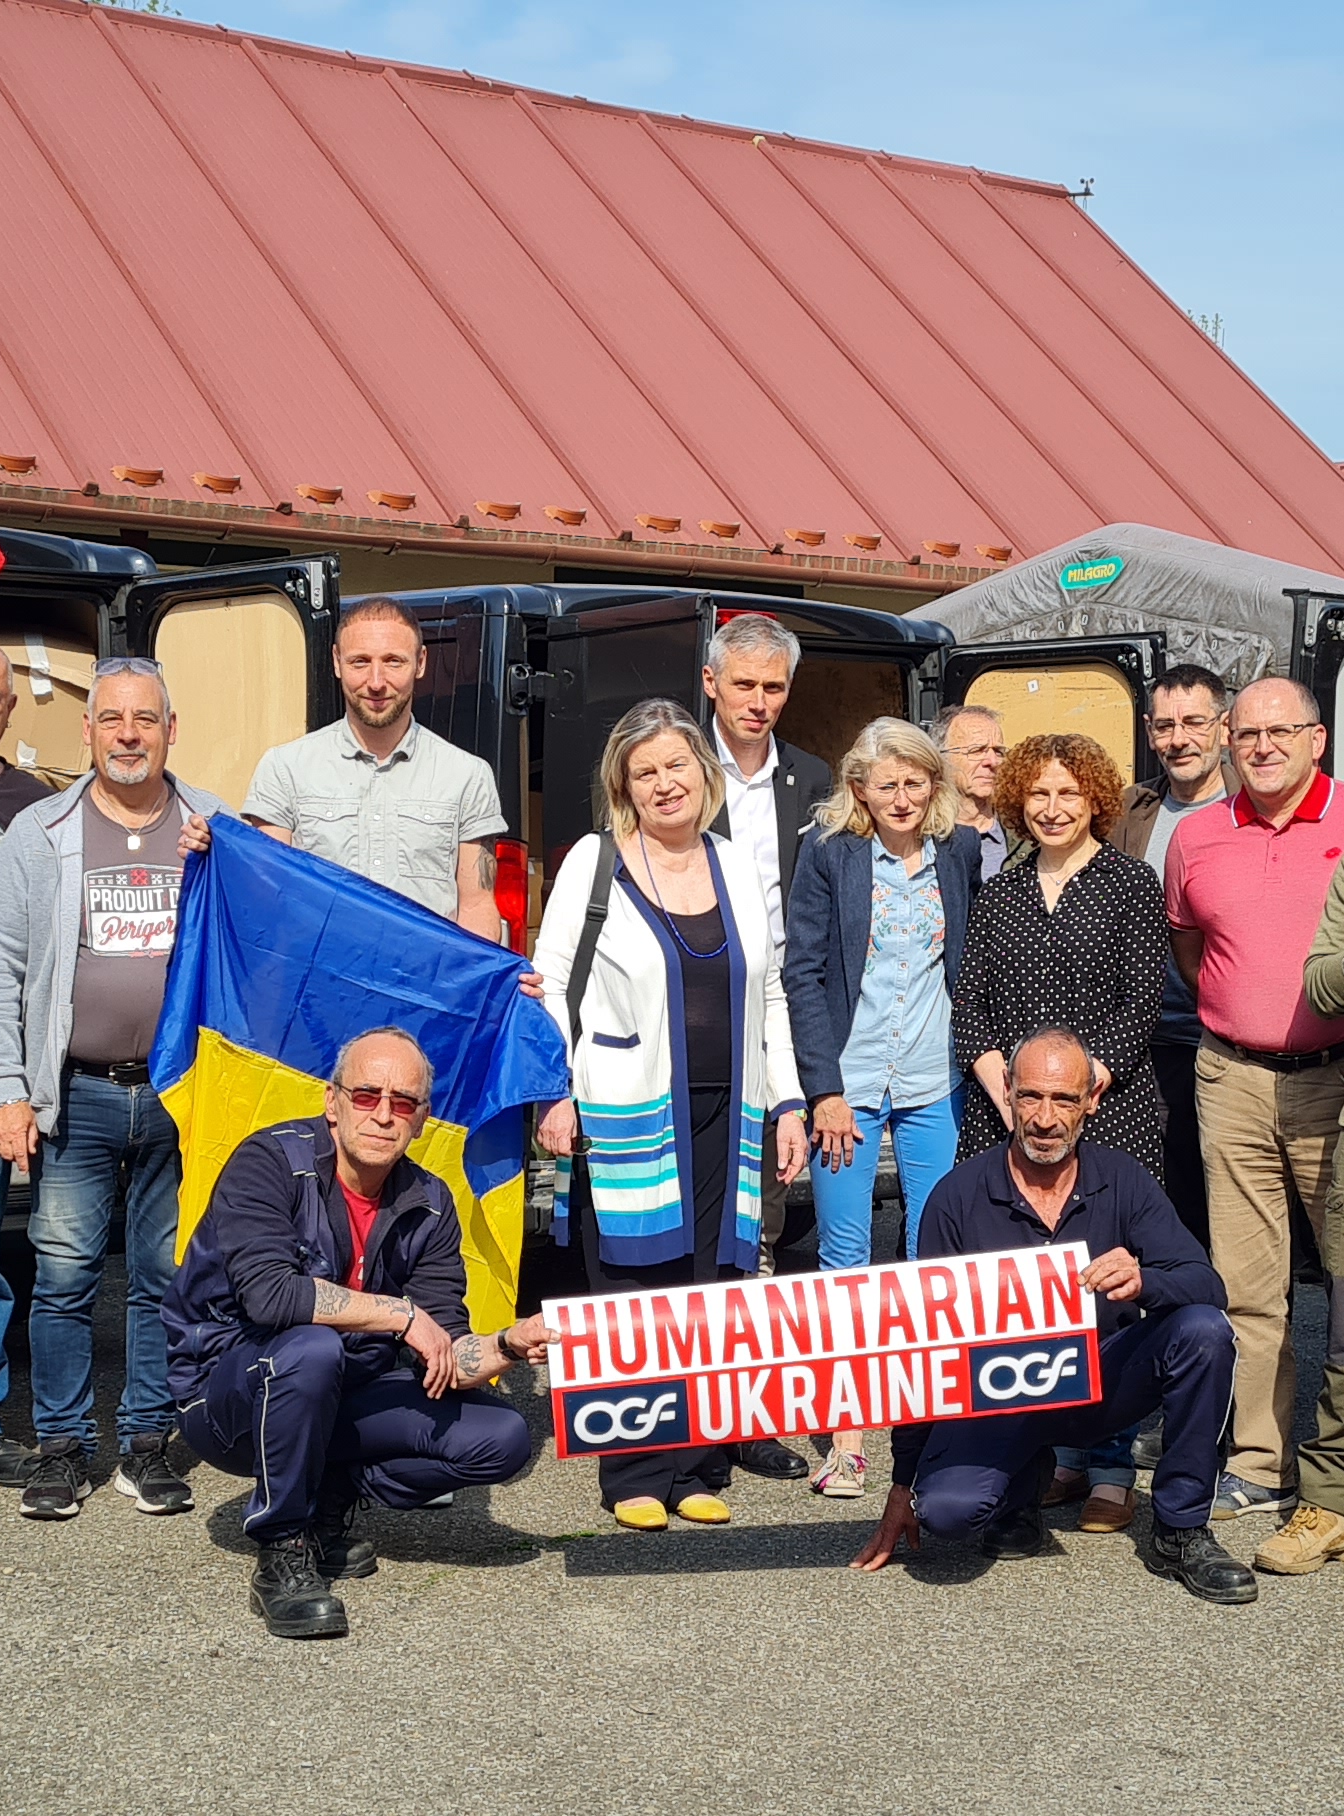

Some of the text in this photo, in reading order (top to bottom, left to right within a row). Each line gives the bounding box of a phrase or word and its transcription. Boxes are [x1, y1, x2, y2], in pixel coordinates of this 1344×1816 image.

[1067, 563, 1116, 583] MILAGRO
[89, 887, 180, 912] PRODUIT D
[98, 915, 175, 947] Périgor
[557, 1250, 1083, 1381] HUMANITARIAN
[573, 1346, 1079, 1445] OGF UKRAINE OGF
